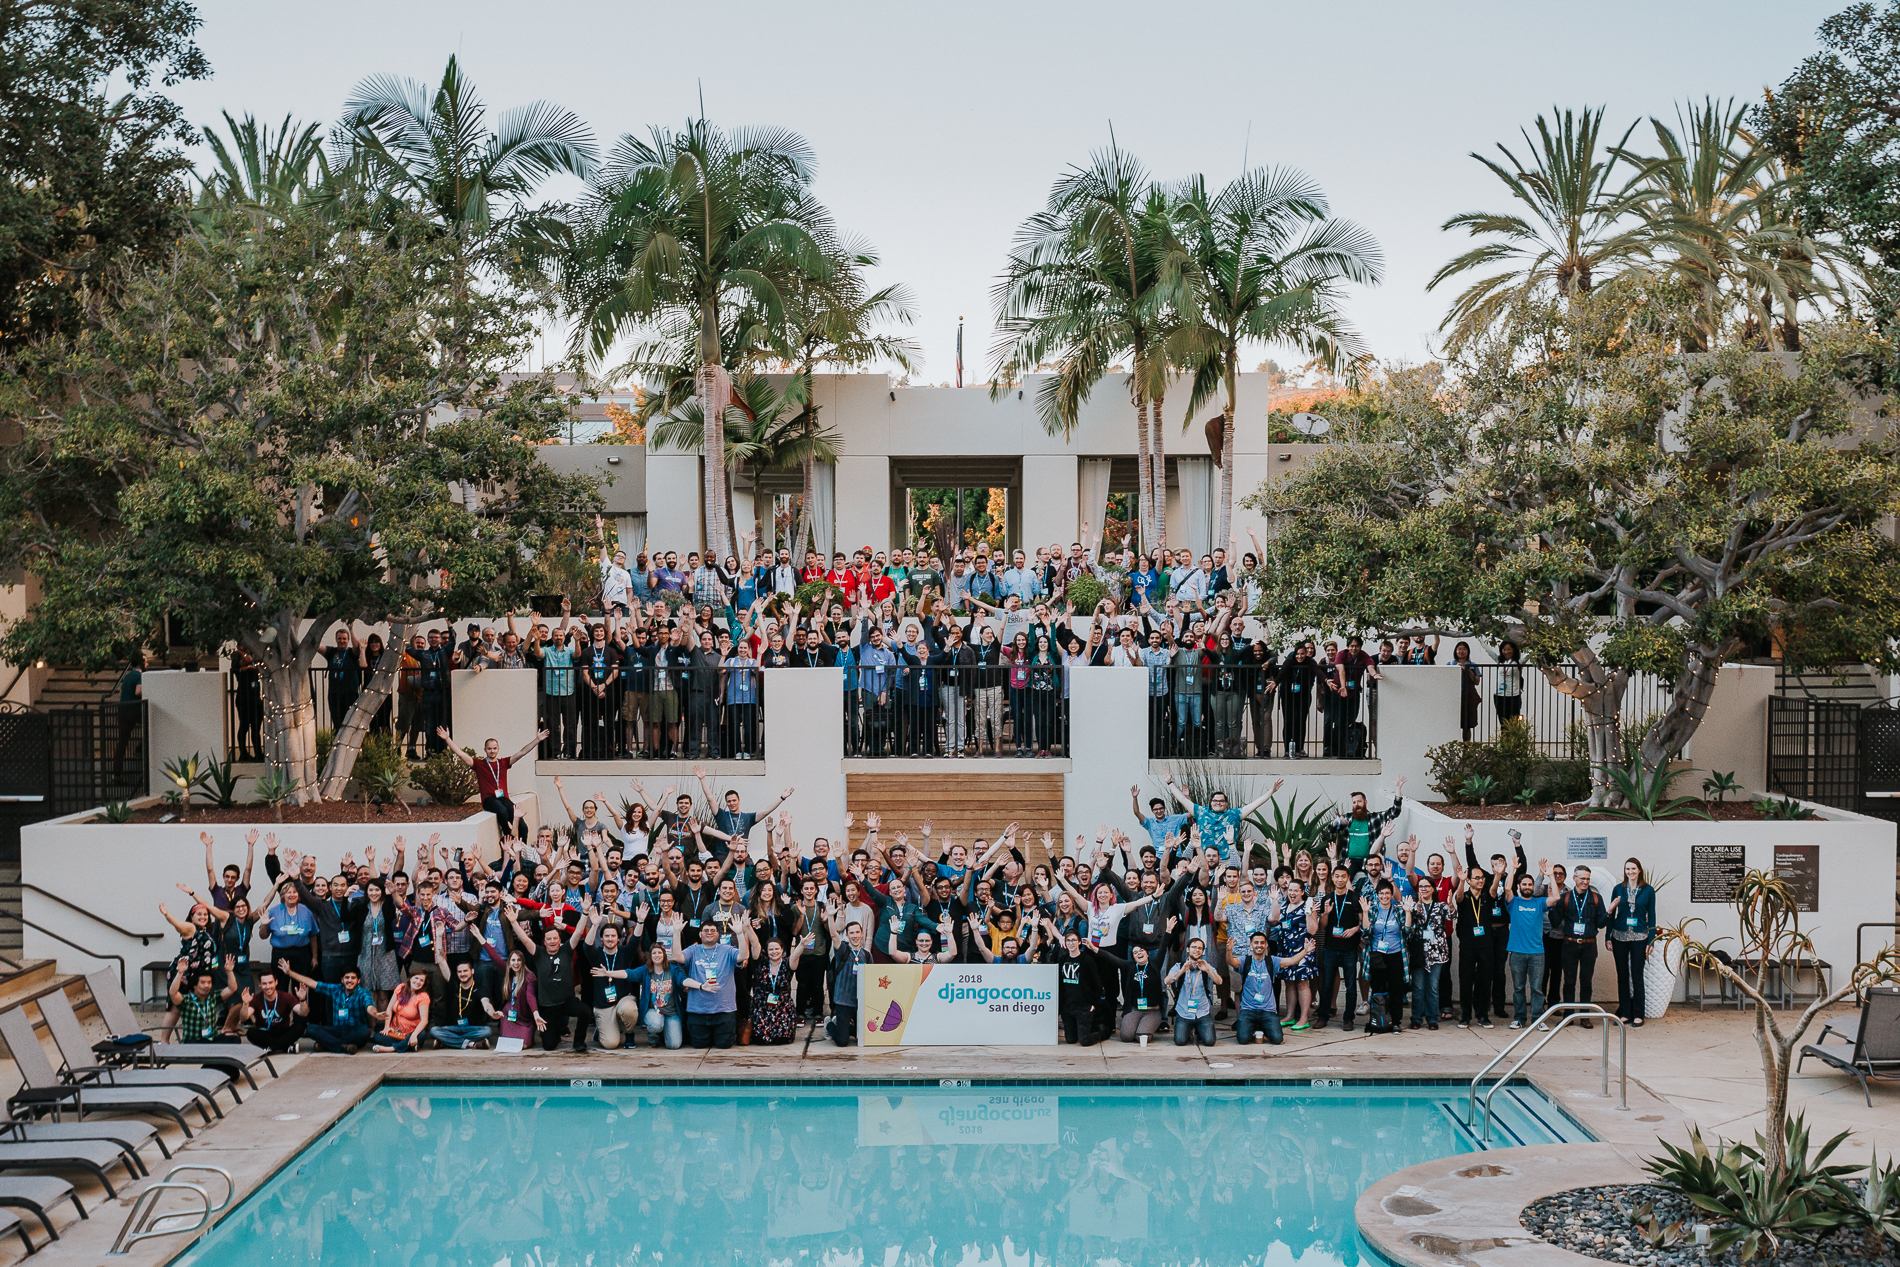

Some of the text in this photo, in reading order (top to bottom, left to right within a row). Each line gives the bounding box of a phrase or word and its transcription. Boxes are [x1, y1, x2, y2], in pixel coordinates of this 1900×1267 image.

[959, 975, 982, 983] 2018
[938, 983, 1051, 1004] djangocon.us
[989, 1002, 1045, 1015] san diego
